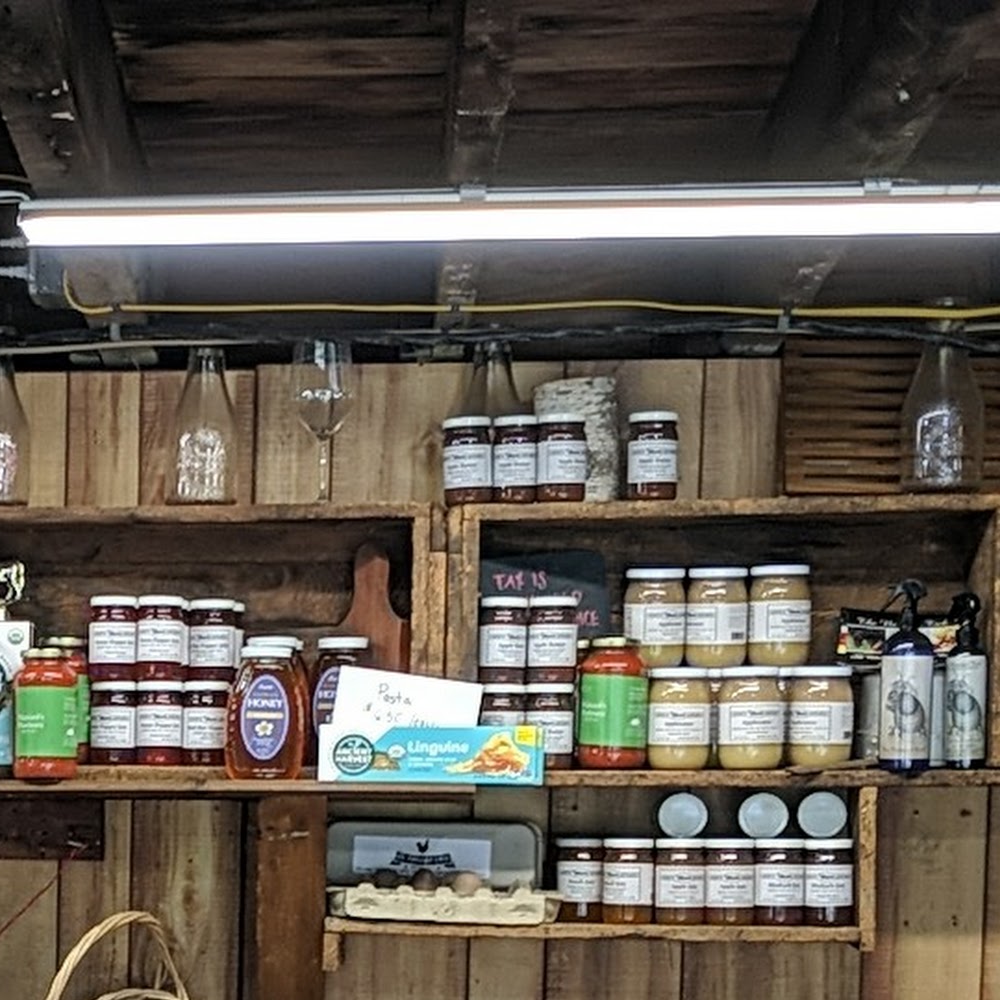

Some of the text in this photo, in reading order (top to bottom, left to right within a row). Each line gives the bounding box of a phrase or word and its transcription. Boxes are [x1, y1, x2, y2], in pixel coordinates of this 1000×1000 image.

[492, 570, 547, 591] TAX IS
[247, 699, 282, 708] HONEY
